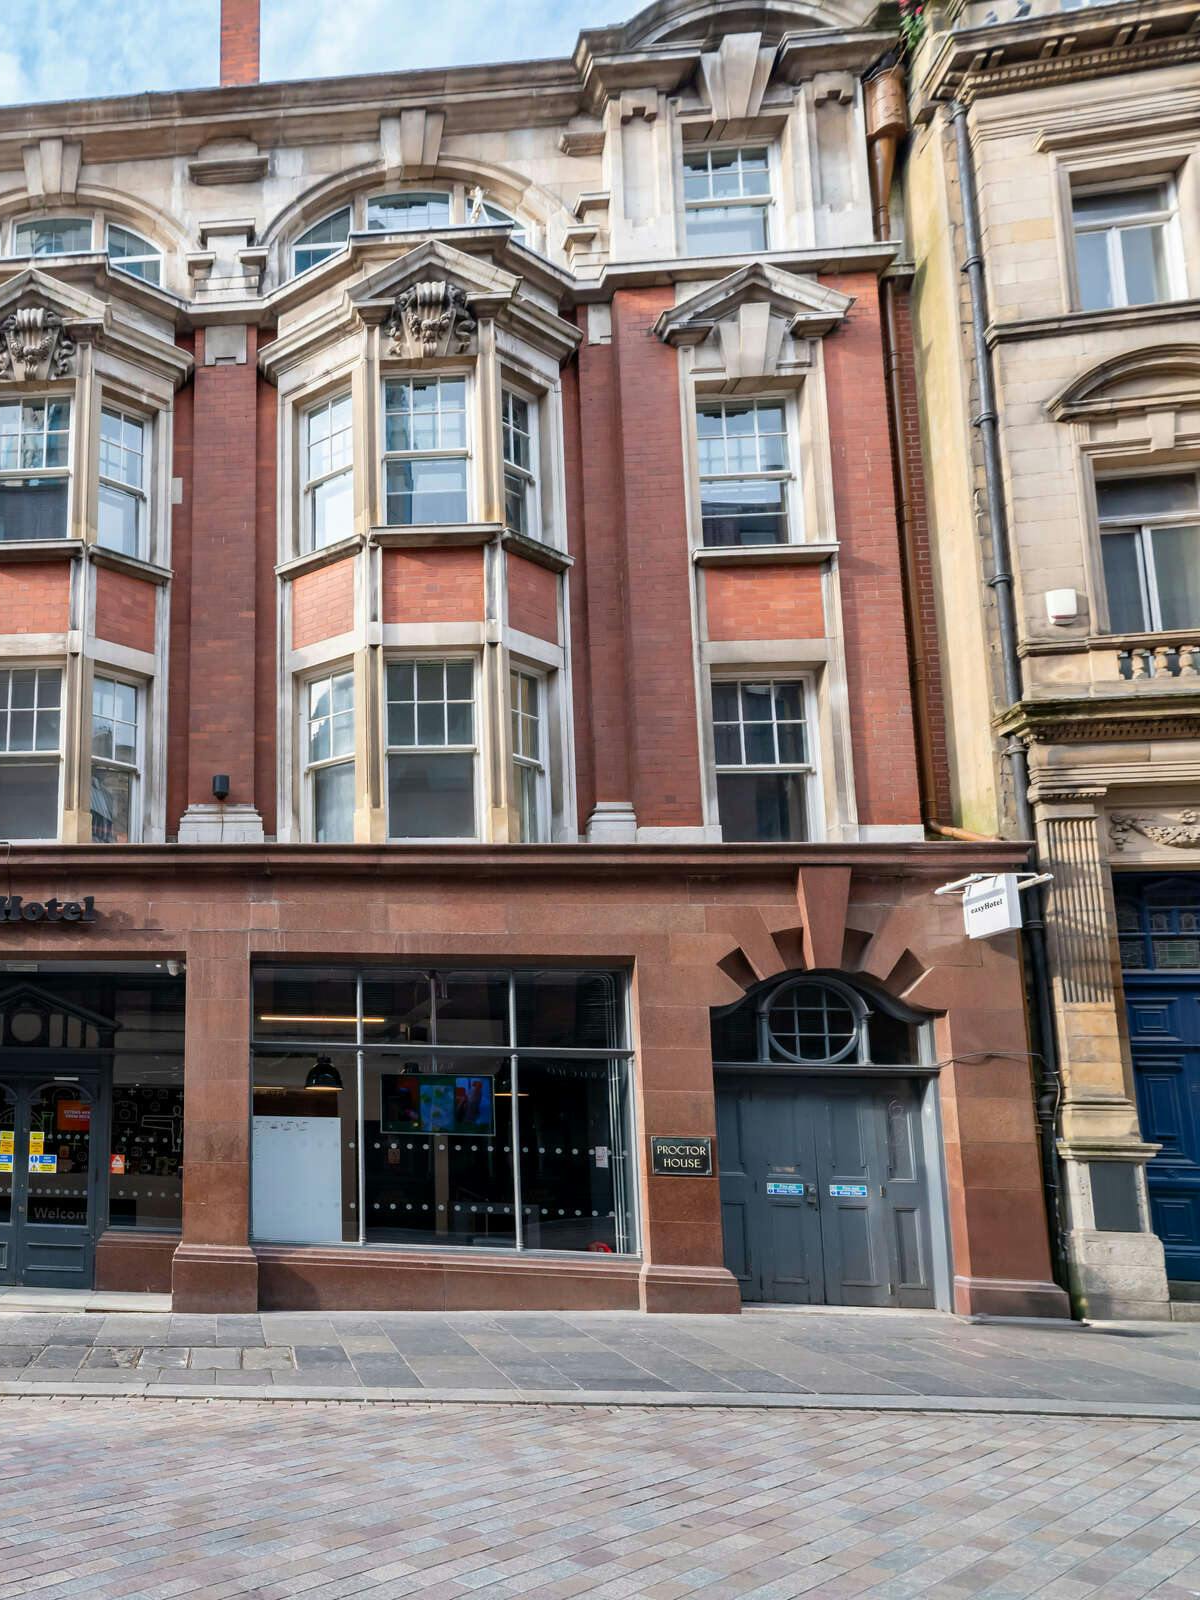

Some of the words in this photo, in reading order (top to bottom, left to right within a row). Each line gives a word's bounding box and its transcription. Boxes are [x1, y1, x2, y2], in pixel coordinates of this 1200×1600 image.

[970, 898, 1003, 914] easyHotel
[656, 1145, 706, 1156] PROCTOR
[663, 1158, 701, 1169] HOUSE
[33, 1207, 88, 1220] Welcom
